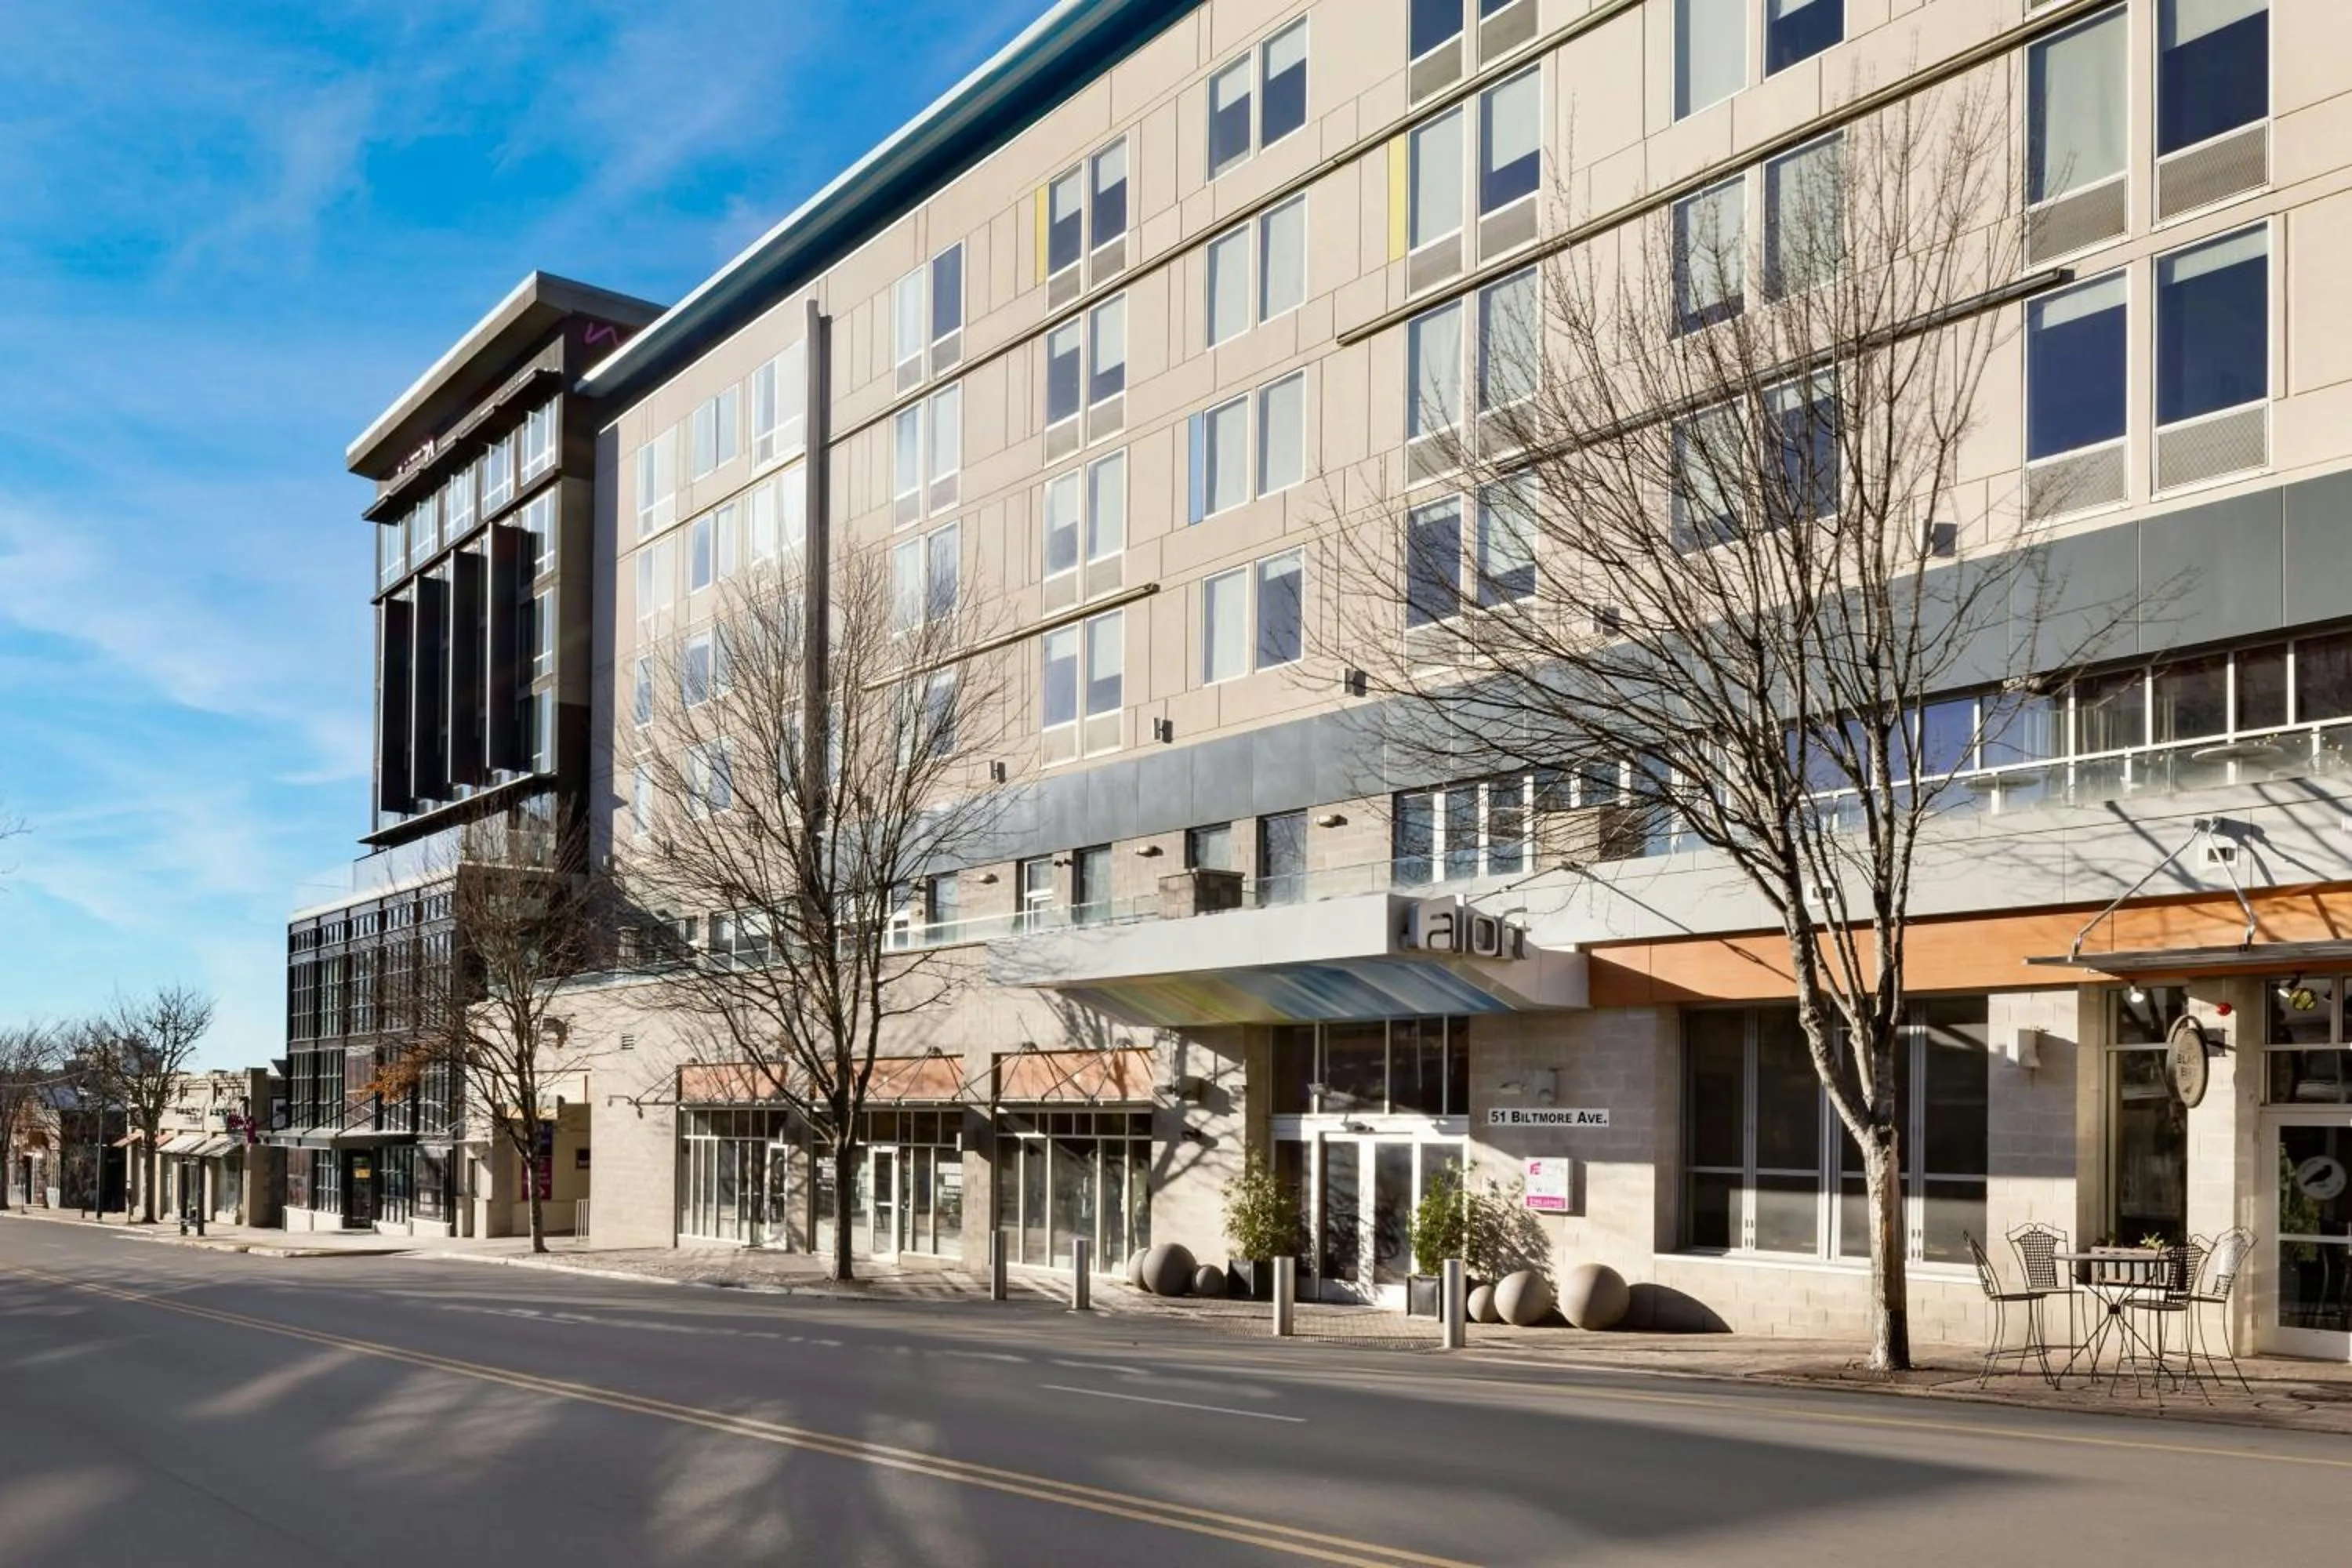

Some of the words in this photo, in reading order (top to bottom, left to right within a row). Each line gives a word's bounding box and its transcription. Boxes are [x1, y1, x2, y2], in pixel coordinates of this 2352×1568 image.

[1491, 1111, 1506, 1123] 51
[1512, 1111, 1572, 1123] BILTMORE
[1577, 1111, 1606, 1123] AVE.
